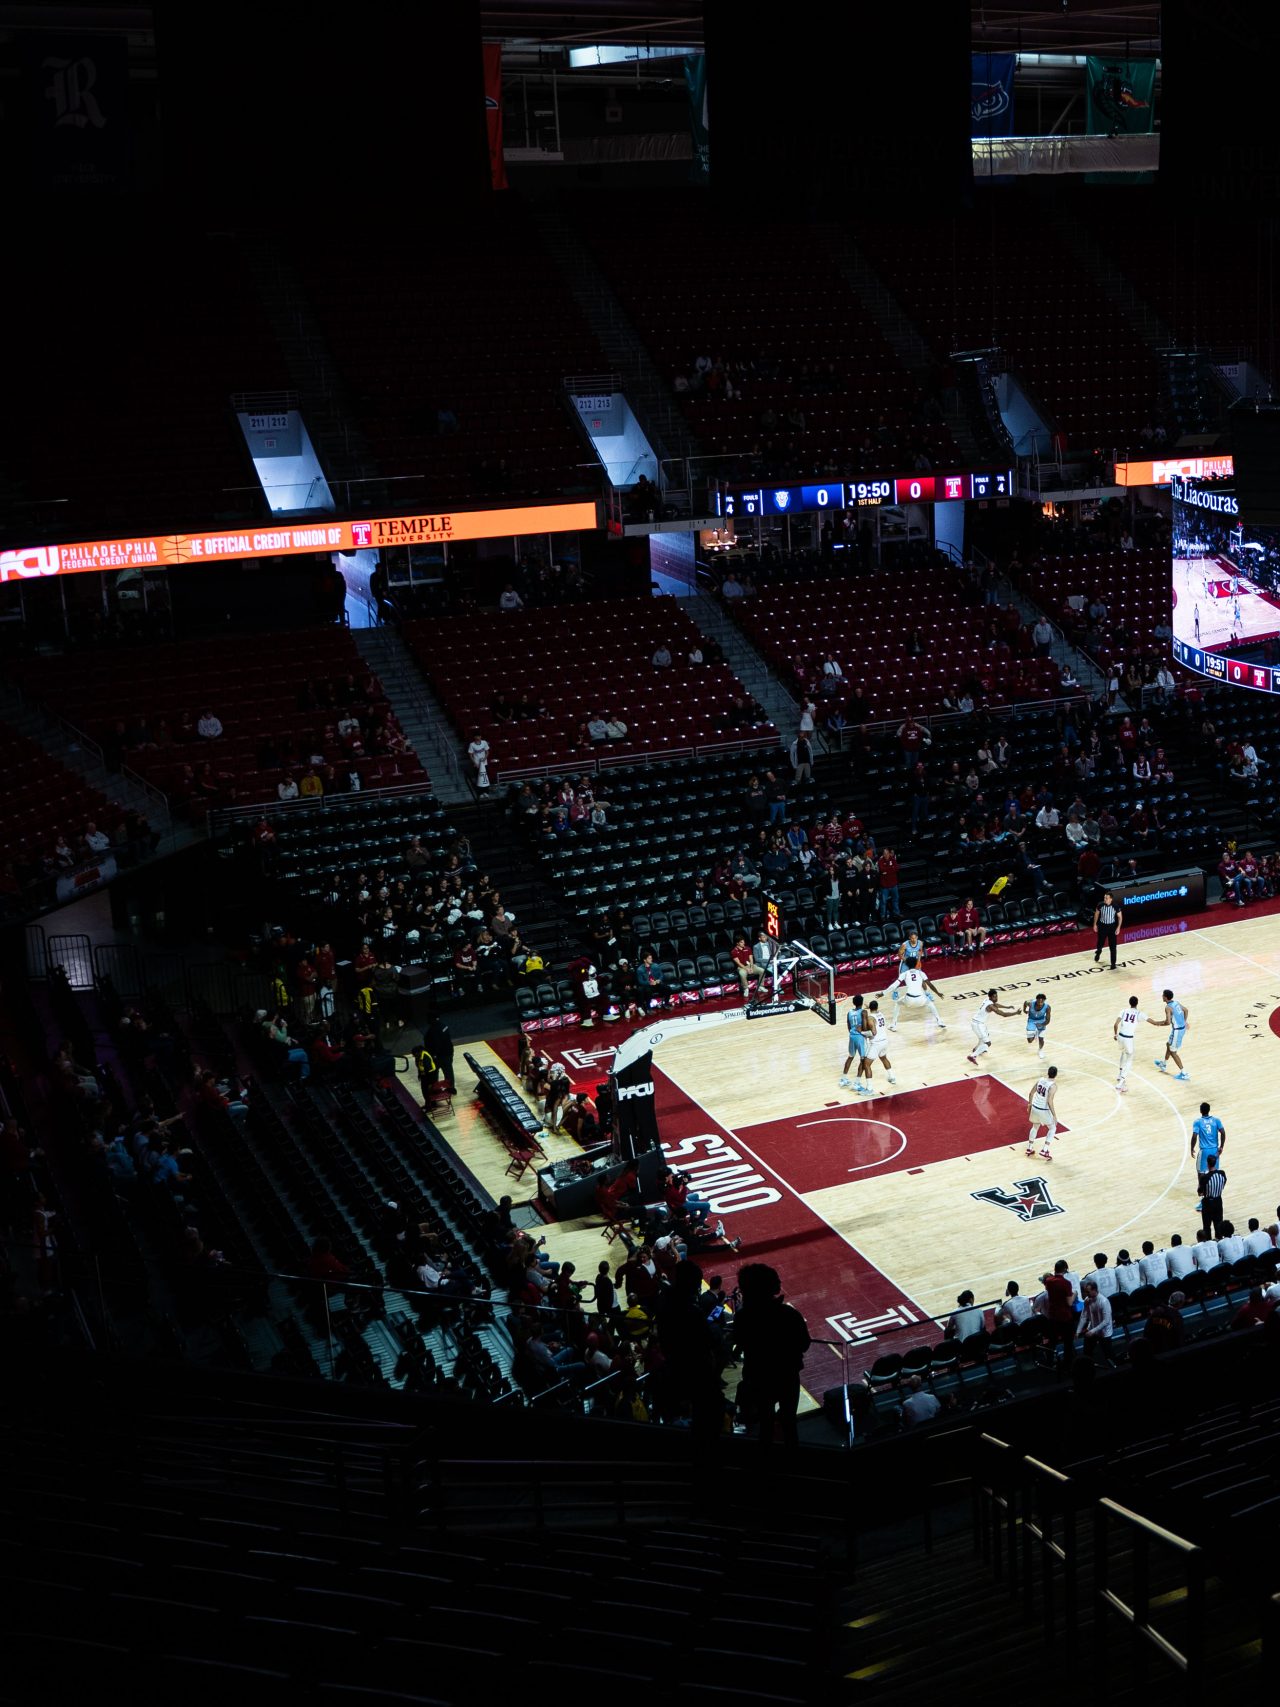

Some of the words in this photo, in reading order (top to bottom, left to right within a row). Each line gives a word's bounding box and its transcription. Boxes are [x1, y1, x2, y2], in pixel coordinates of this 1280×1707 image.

[252, 419, 264, 427] 211
[272, 417, 286, 426] 212
[1152, 460, 1203, 483] PFCU
[850, 482, 890, 499] 19:50
[910, 482, 921, 498] 0
[979, 484, 985, 494] 0
[998, 483, 1004, 493] 4
[1171, 475, 1182, 501] The
[1184, 481, 1239, 514] Liacouras
[817, 489, 828, 506] 0
[726, 504, 734, 514] 4
[747, 502, 754, 513] 0
[352, 524, 370, 544] T
[374, 516, 452, 536] TEMPLE
[204, 535, 252, 554] OFFICIAL
[253, 532, 290, 551] CREDIT
[292, 530, 326, 548] UNION
[328, 528, 341, 545] OF
[378, 532, 452, 544] UNIVERSITY
[62, 542, 157, 560] PHILADELPHIA
[0, 546, 60, 581] FCU
[62, 558, 97, 569] FEDERAL
[100, 555, 129, 566] CREDIT
[132, 553, 157, 564] UNION
[1195, 654, 1200, 666] 0
[1206, 656, 1225, 672] 19:51
[1234, 666, 1241, 679] 0
[1124, 889, 1178, 906] Independence
[768, 913, 778, 937] 24
[1151, 950, 1187, 962] THE
[911, 973, 916, 981] 2
[750, 1006, 787, 1016] Independence
[1124, 1013, 1136, 1024] 14
[878, 1017, 885, 1028] 33
[618, 1082, 654, 1101] PFCU
[1205, 1124, 1212, 1134] 3
[660, 1133, 783, 1215] OWLS
